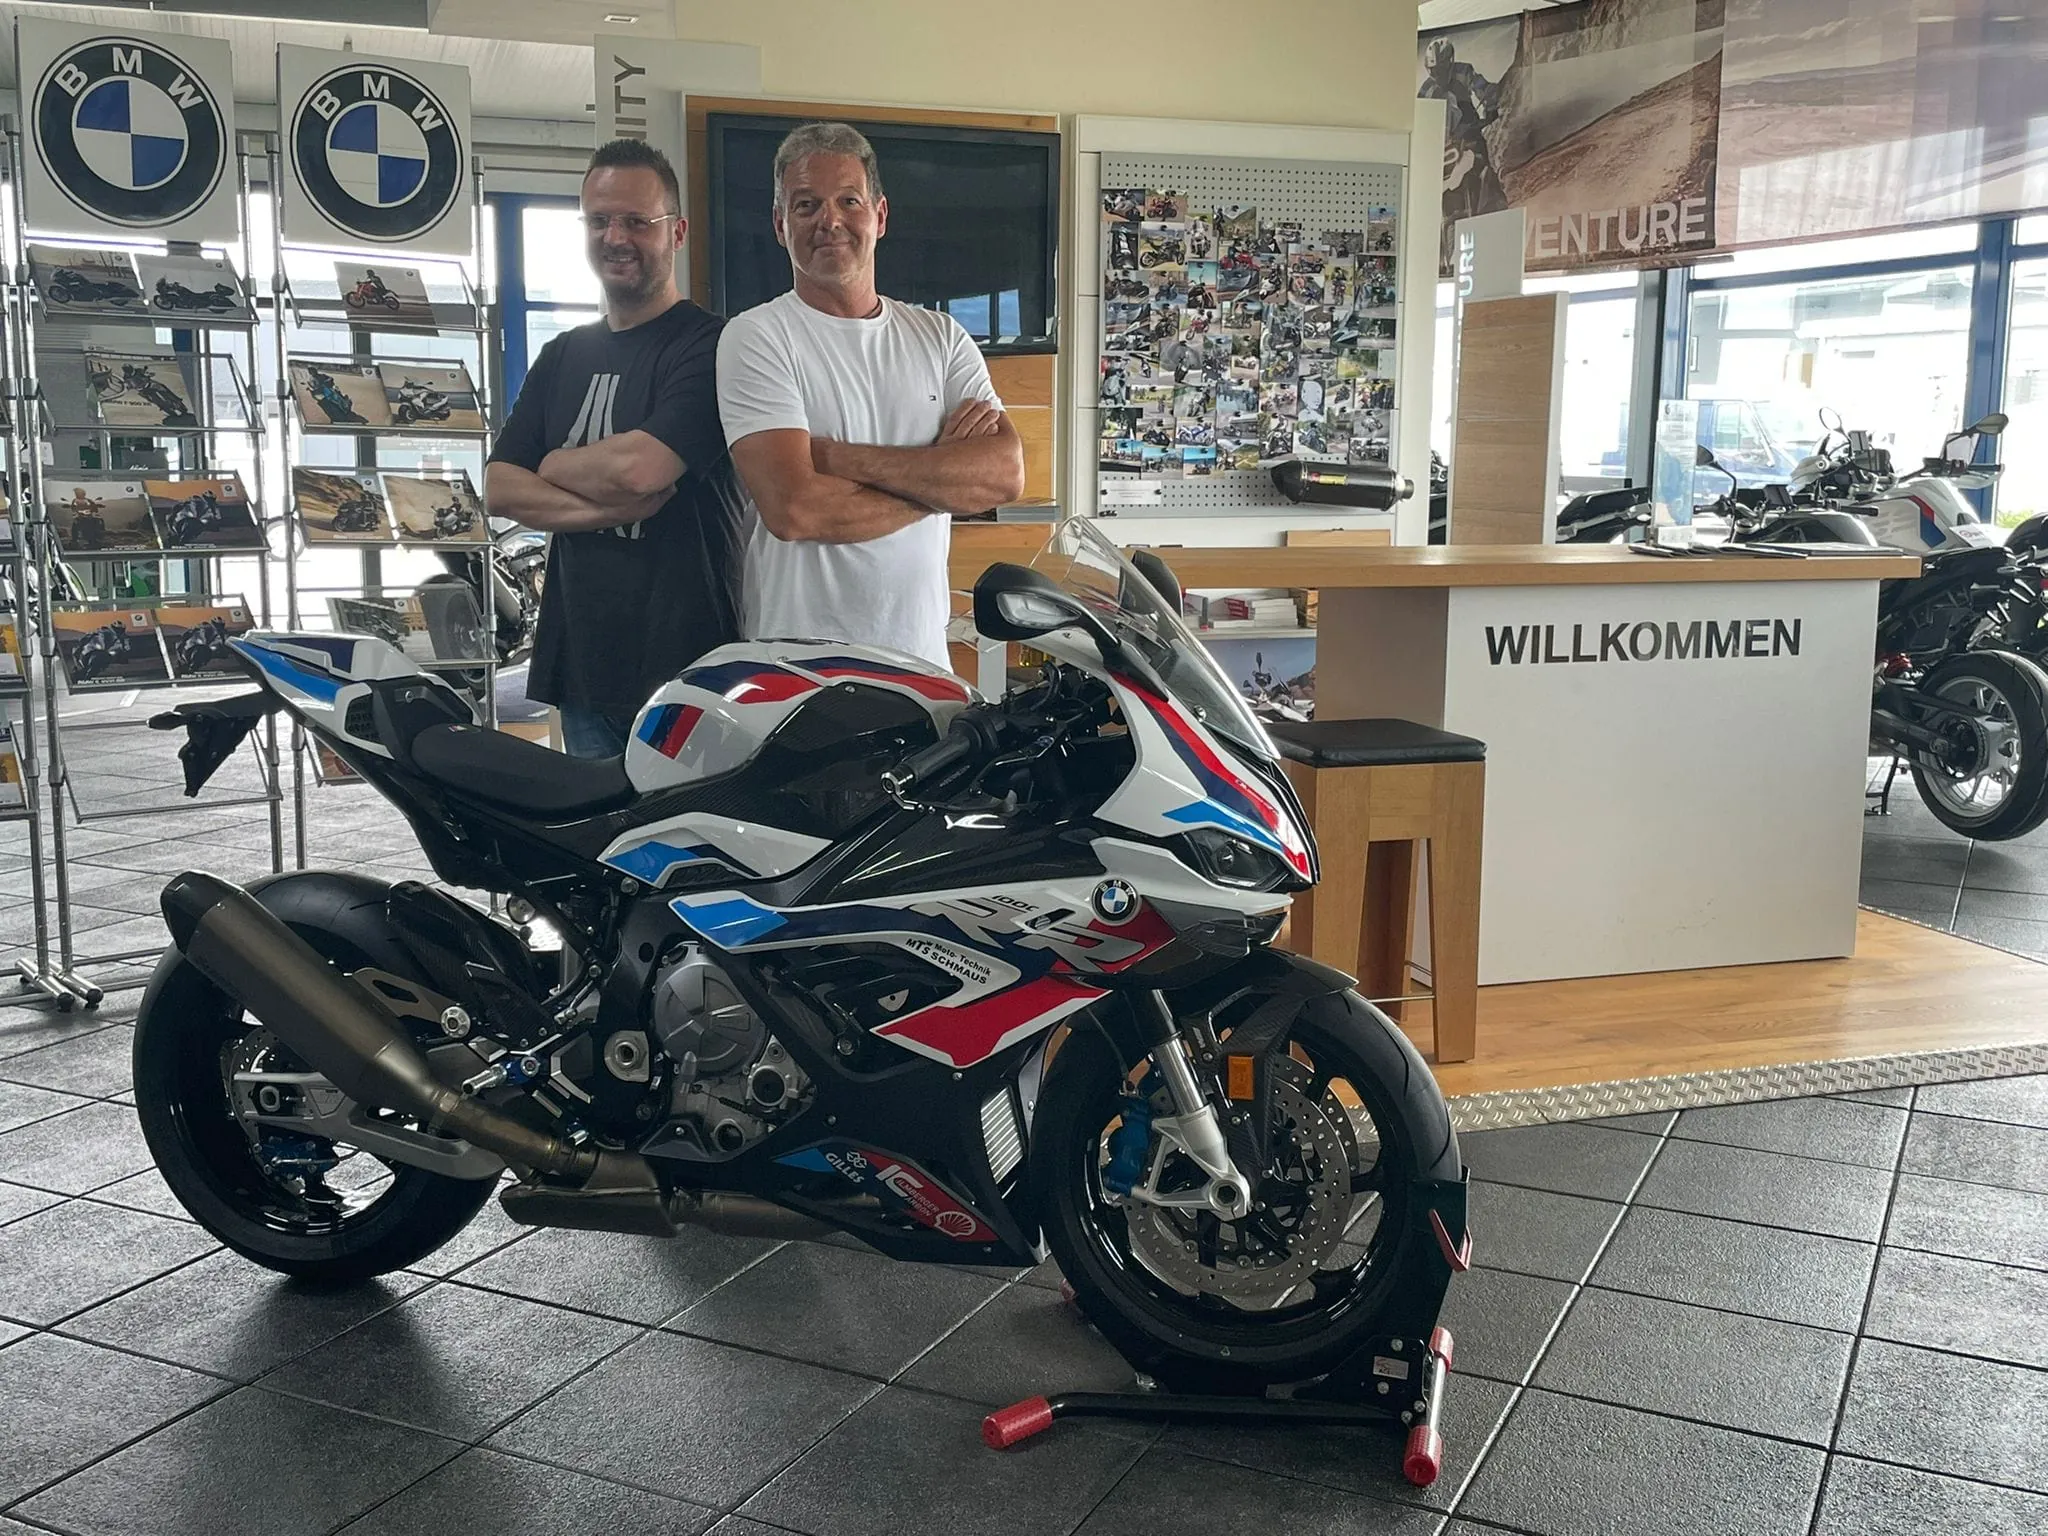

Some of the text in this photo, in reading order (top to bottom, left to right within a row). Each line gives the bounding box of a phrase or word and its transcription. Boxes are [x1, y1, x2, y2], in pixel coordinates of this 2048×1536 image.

[54, 47, 203, 109] BMW
[310, 73, 443, 132] BMW
[1485, 618, 1802, 666] WILLKOMMEN
[905, 938, 987, 985] MTS SCHMAUS
[960, 954, 992, 976] Technik
[825, 1152, 865, 1183] GILLES
